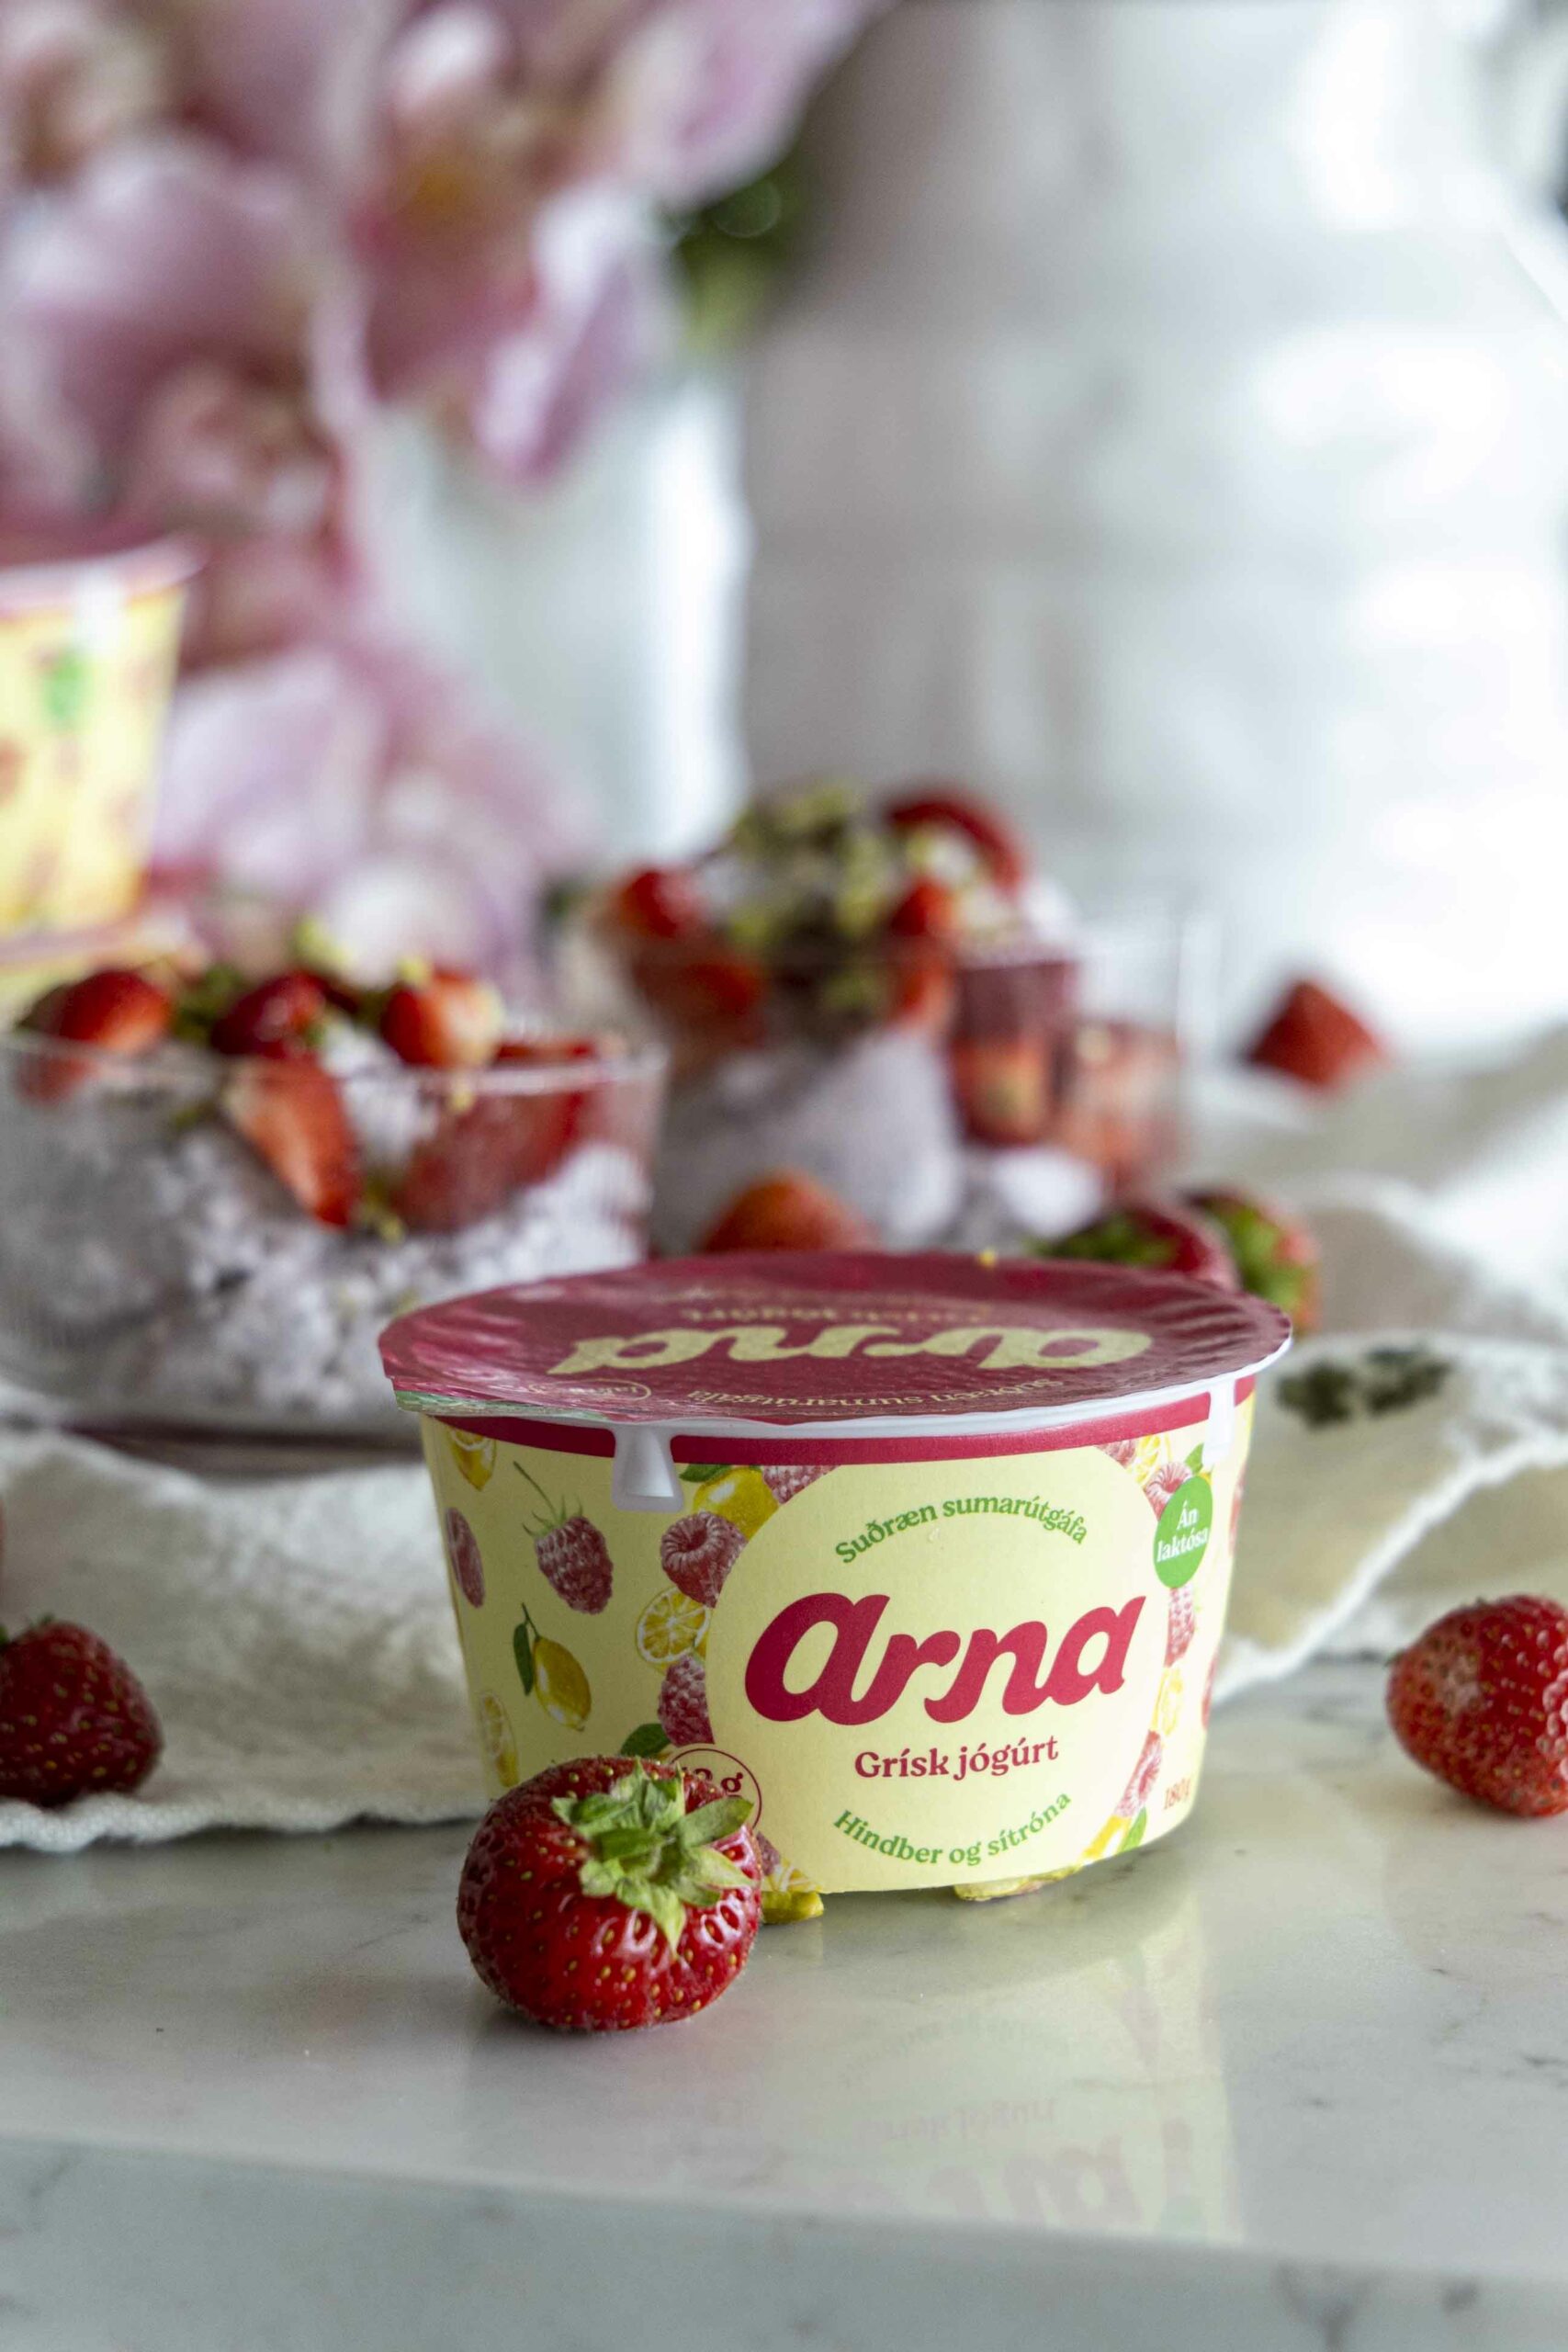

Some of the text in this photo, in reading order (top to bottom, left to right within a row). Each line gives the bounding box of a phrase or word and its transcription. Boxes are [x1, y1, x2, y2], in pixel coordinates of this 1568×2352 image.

[546, 1325, 1154, 1375] arna
[833, 1493, 1089, 1564] Suðræn sumarútgáfa
[1176, 1498, 1200, 1531] Án
[1156, 1526, 1209, 1563] laktósa
[745, 1592, 1146, 1726] arna
[854, 1736, 1058, 1781] Grísk jógúrt
[833, 1792, 1072, 1868] Hindber og sítróna
